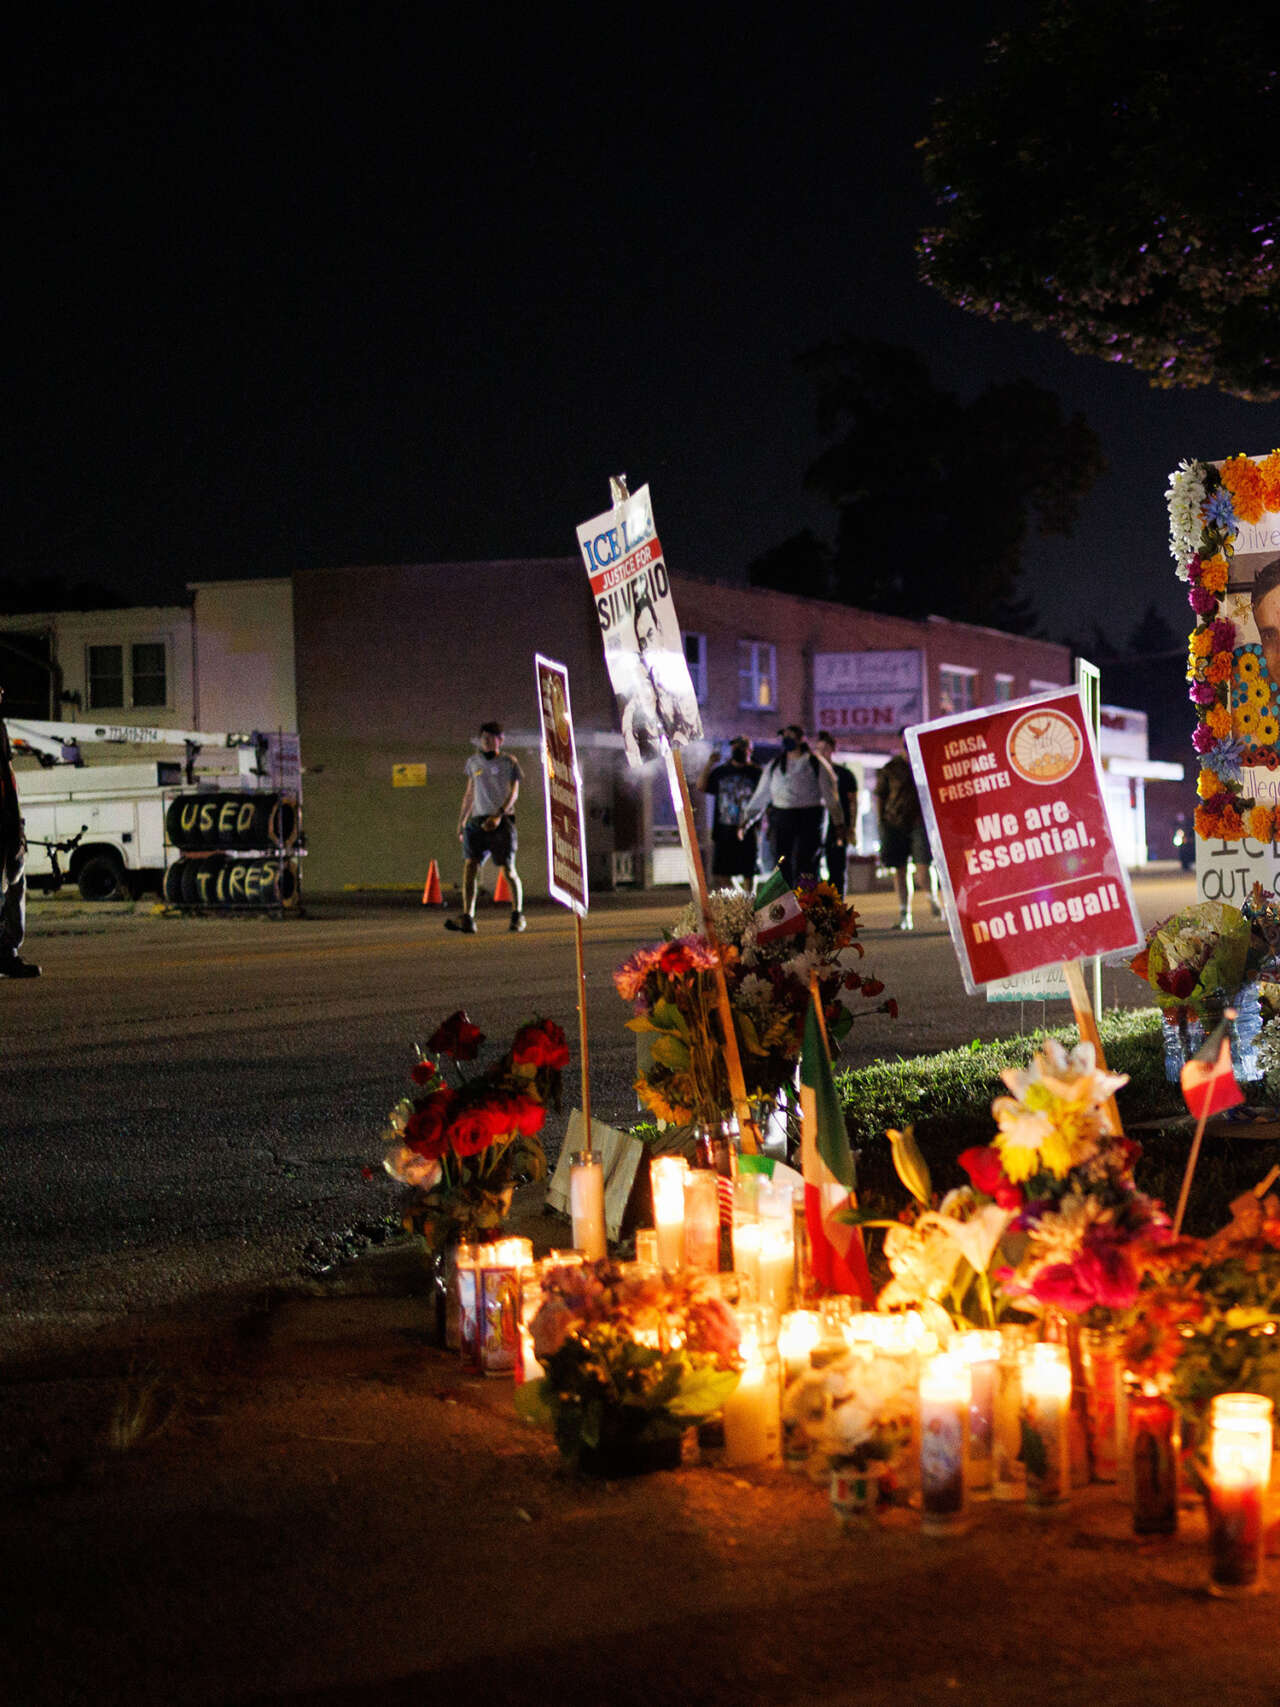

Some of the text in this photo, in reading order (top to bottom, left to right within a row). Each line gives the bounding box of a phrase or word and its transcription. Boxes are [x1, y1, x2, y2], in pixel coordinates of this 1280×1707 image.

[584, 527, 622, 572] ICE
[602, 545, 653, 590] JUSTICE FOR
[820, 705, 895, 728] SIGN
[942, 752, 998, 780] DUPAGE
[181, 801, 256, 833] USED
[974, 800, 1070, 843] We are
[964, 821, 1096, 876] Essential,
[197, 861, 280, 901] TIRES
[1202, 868, 1250, 900] OUT
[972, 883, 1120, 944] not Illegal!
